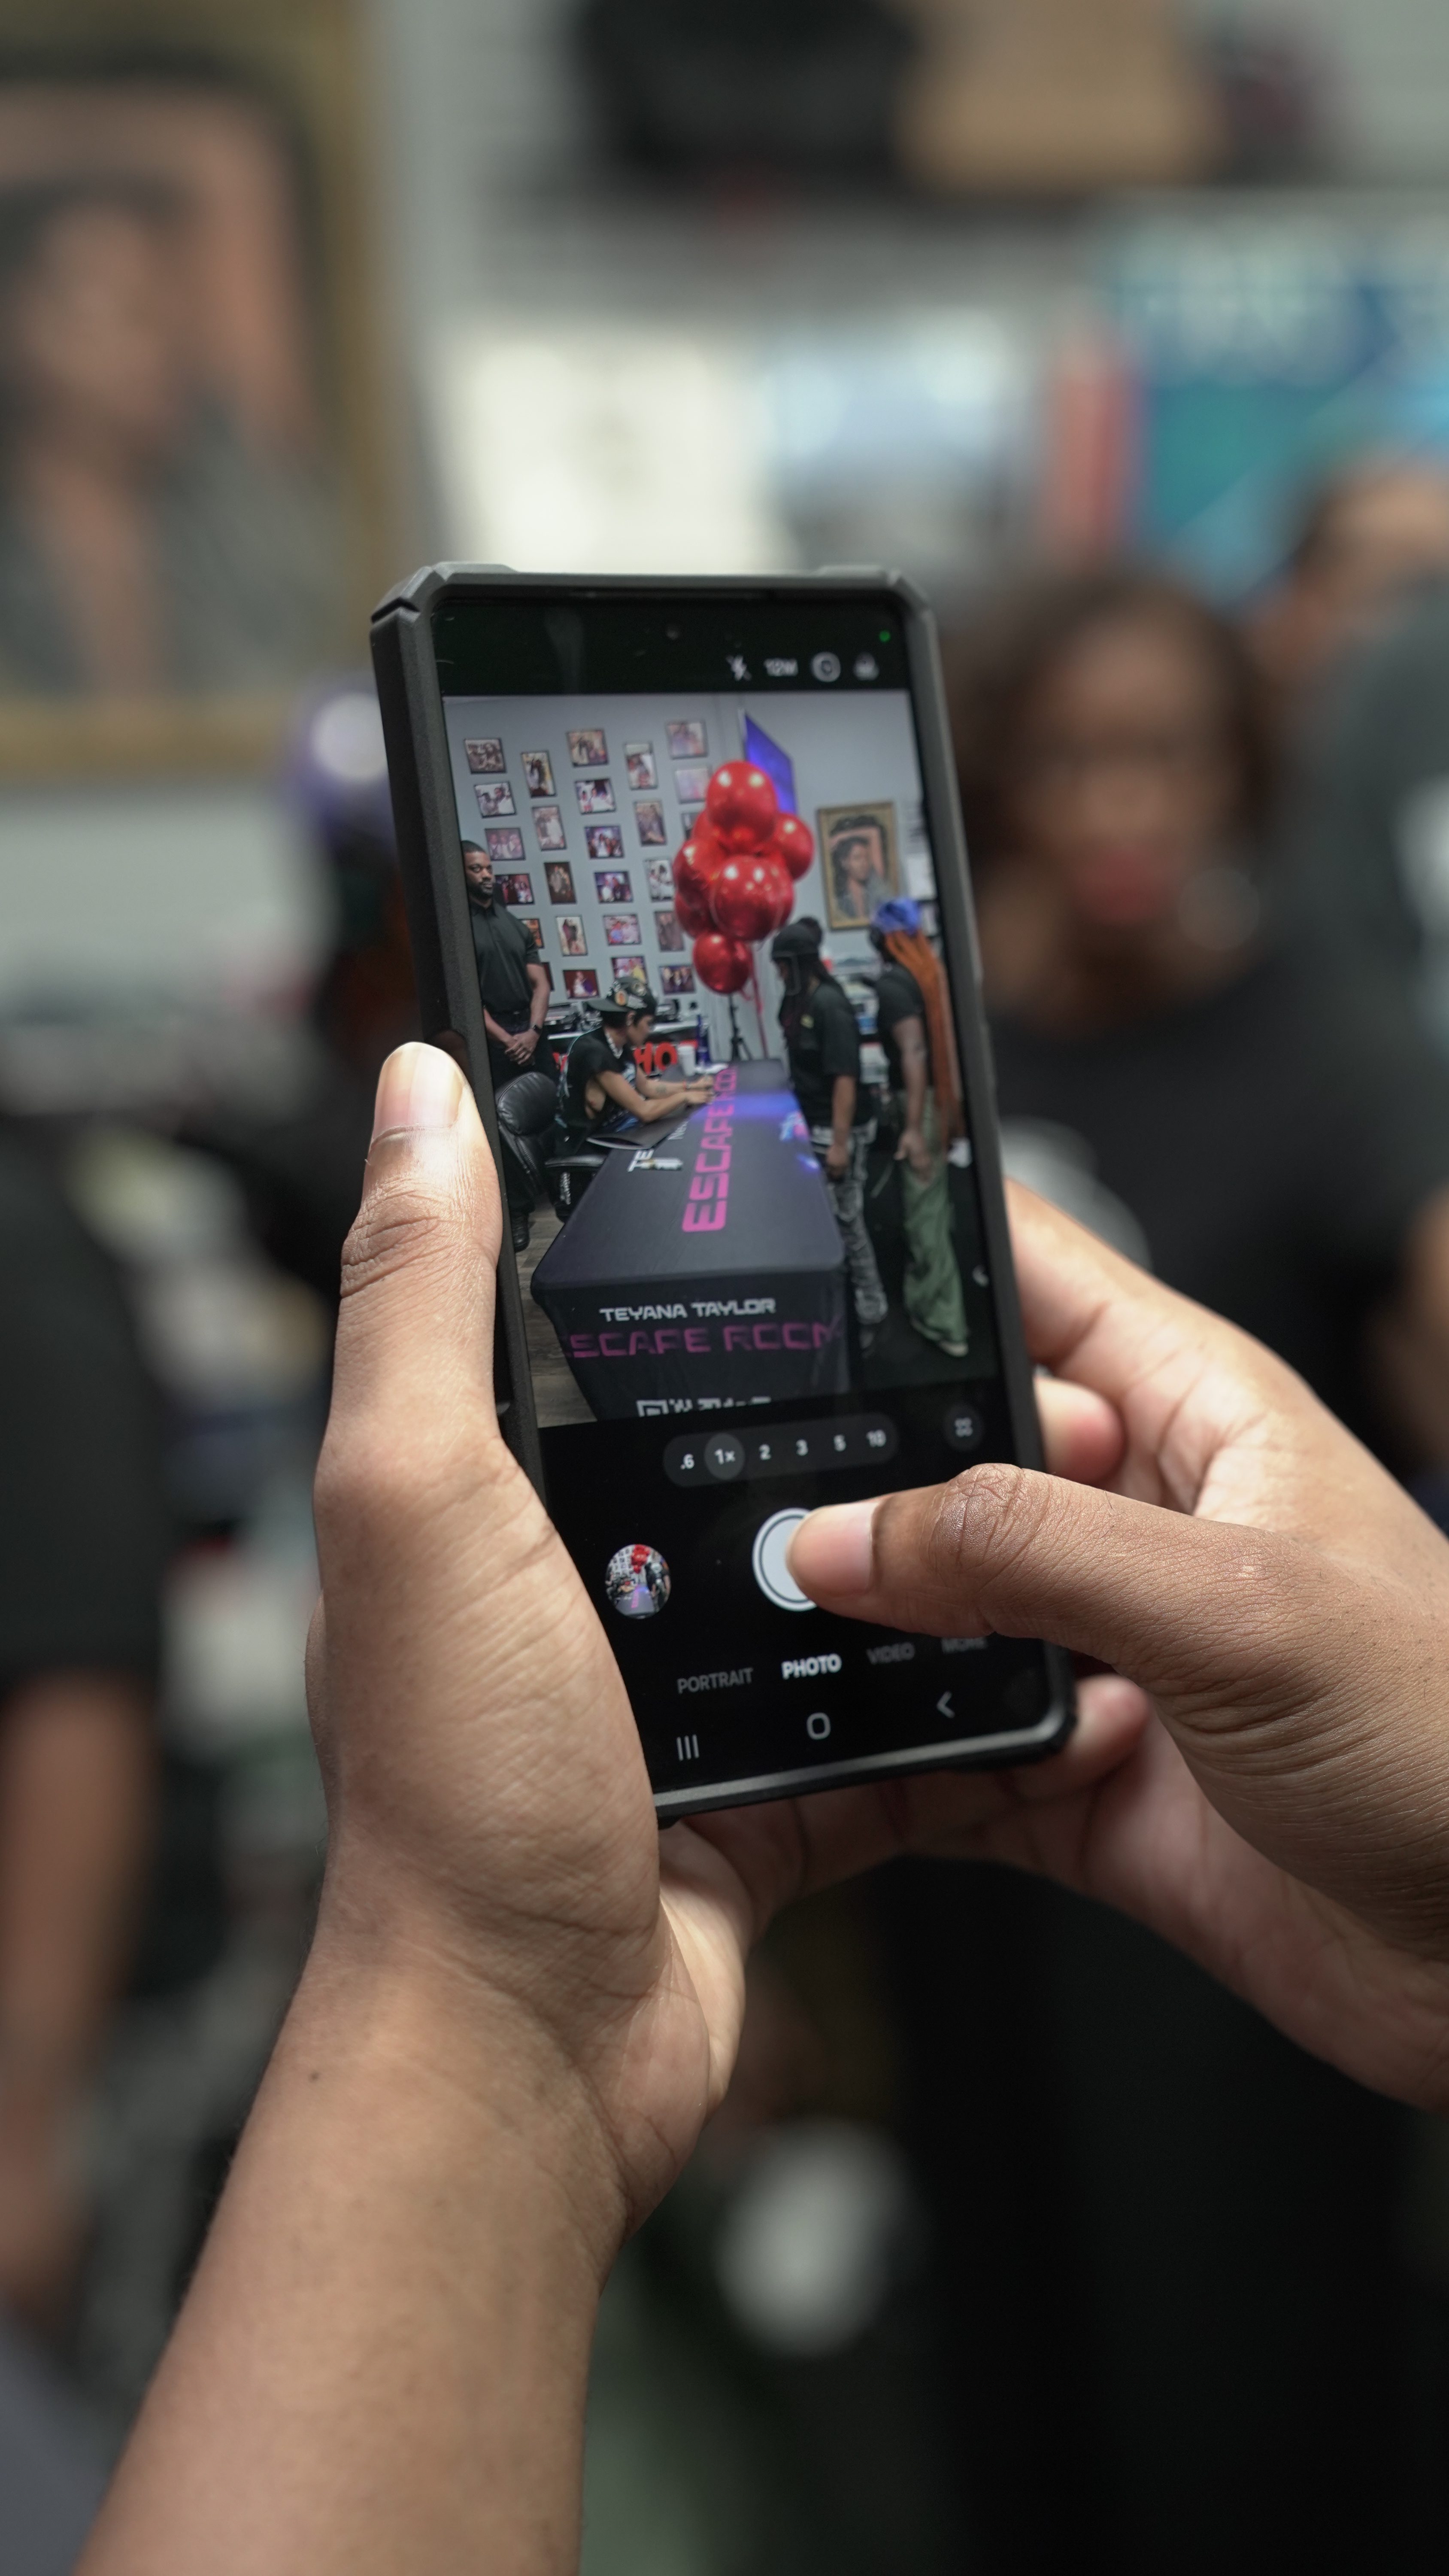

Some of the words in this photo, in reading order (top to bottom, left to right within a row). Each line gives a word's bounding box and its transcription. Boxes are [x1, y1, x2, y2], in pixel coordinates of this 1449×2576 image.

[682, 1103, 735, 1233] ESCAPE
[599, 1303, 688, 1322] TEYANA
[690, 1297, 776, 1318] TAYLOR
[566, 1328, 711, 1358] SCAPE
[680, 1453, 695, 1470] .6
[714, 1448, 735, 1465] 1x
[759, 1444, 771, 1461] 2
[796, 1439, 809, 1456] 3
[834, 1434, 846, 1452] 5
[866, 1429, 887, 1447] 10
[676, 1667, 754, 1694] PORTRAIT
[781, 1653, 842, 1680] PHOTO
[866, 1641, 915, 1665] VIDEO
